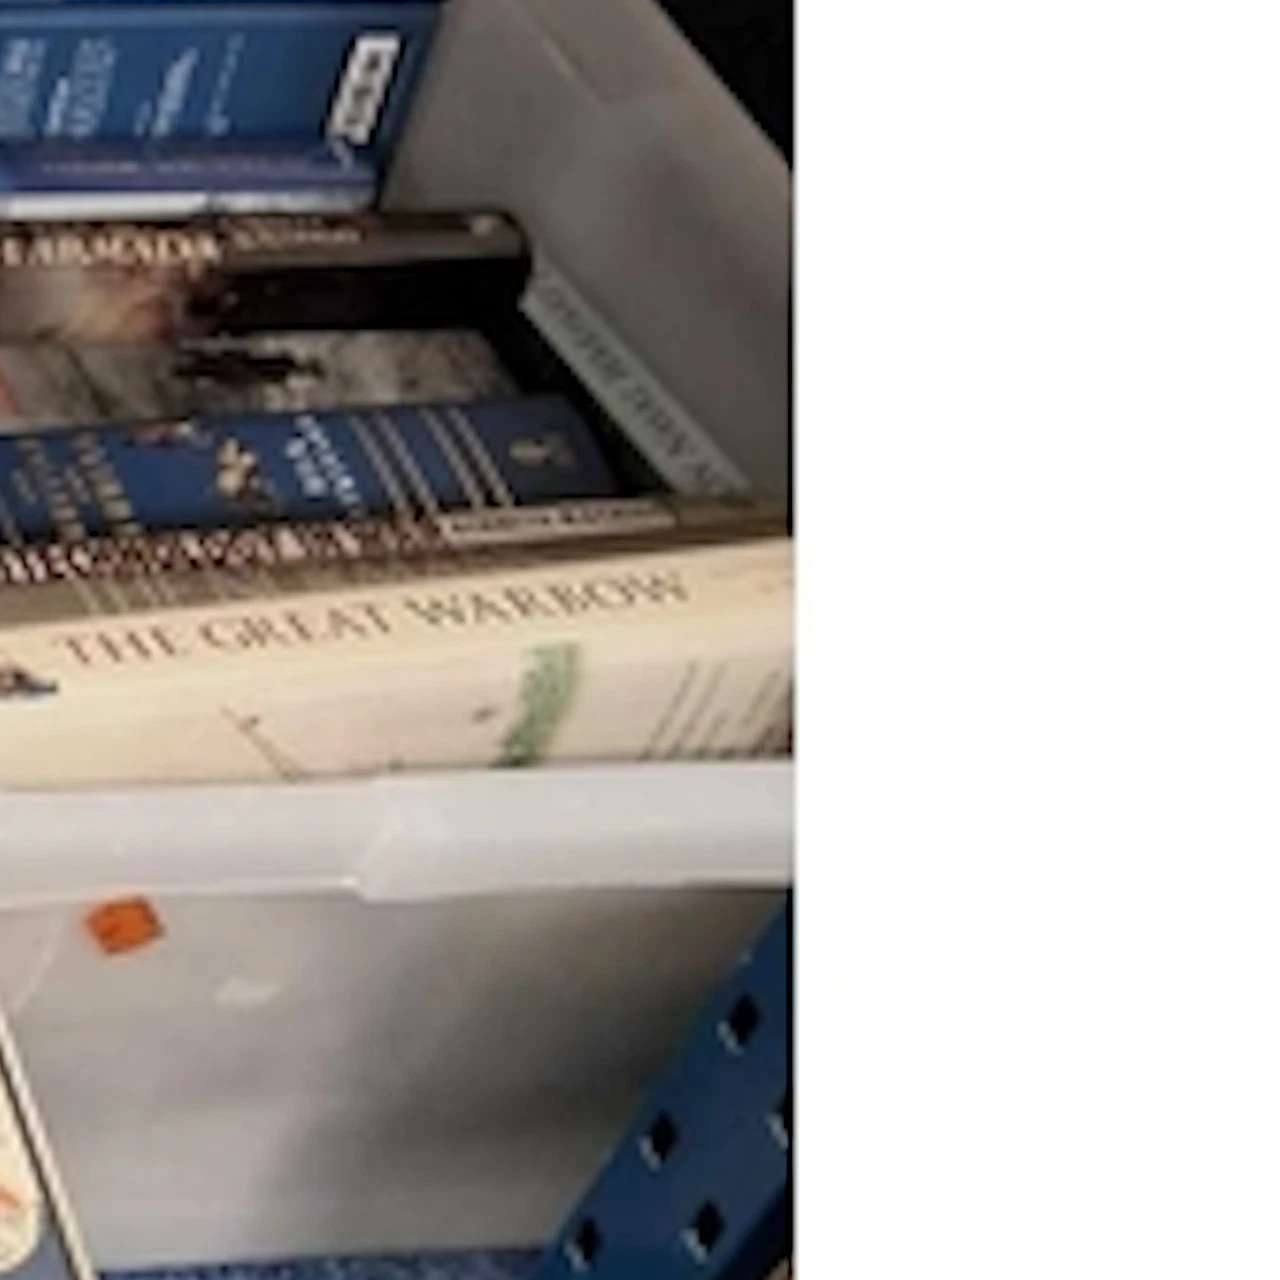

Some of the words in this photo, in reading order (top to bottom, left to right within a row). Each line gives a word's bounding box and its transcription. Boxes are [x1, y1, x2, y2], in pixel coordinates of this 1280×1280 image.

[32, 228, 224, 273] ARMADA
[54, 626, 197, 669] THE
[202, 604, 397, 654] GREAT
[402, 569, 694, 632] WARBOW
